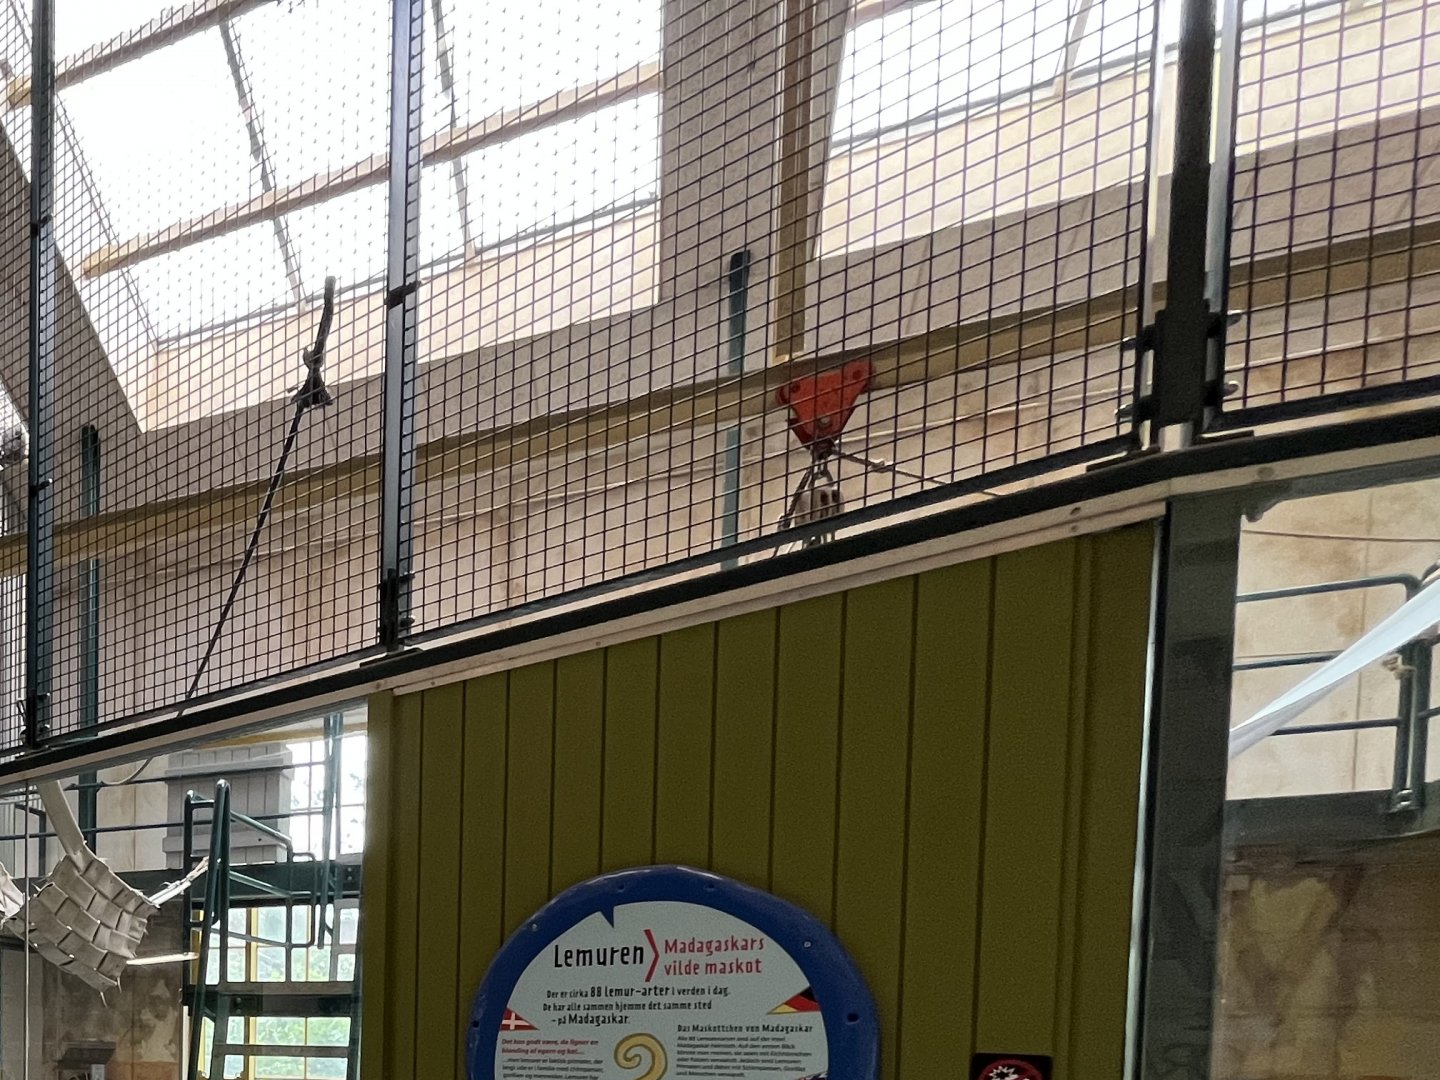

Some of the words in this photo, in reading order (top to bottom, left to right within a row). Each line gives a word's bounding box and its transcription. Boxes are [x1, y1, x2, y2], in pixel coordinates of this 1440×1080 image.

[554, 944, 644, 968] Lemuren
[664, 935, 764, 956] Madagaskars
[664, 960, 700, 976] vilde
[705, 958, 762, 974] maskot
[546, 990, 558, 998] Der
[569, 988, 588, 998] cirka
[590, 986, 602, 997] 88
[605, 985, 670, 997] lemur-arter
[677, 986, 705, 995] verden
[543, 1003, 551, 1011] De
[553, 1003, 565, 1011] har
[567, 1002, 581, 1011] alle
[648, 1001, 661, 1010] det
[663, 1002, 691, 1010] samme
[694, 1000, 712, 1010] sted
[678, 1024, 690, 1032] Das
[692, 1024, 743, 1032] Maskottchen
[762, 1024, 812, 1035] Madagaskar
